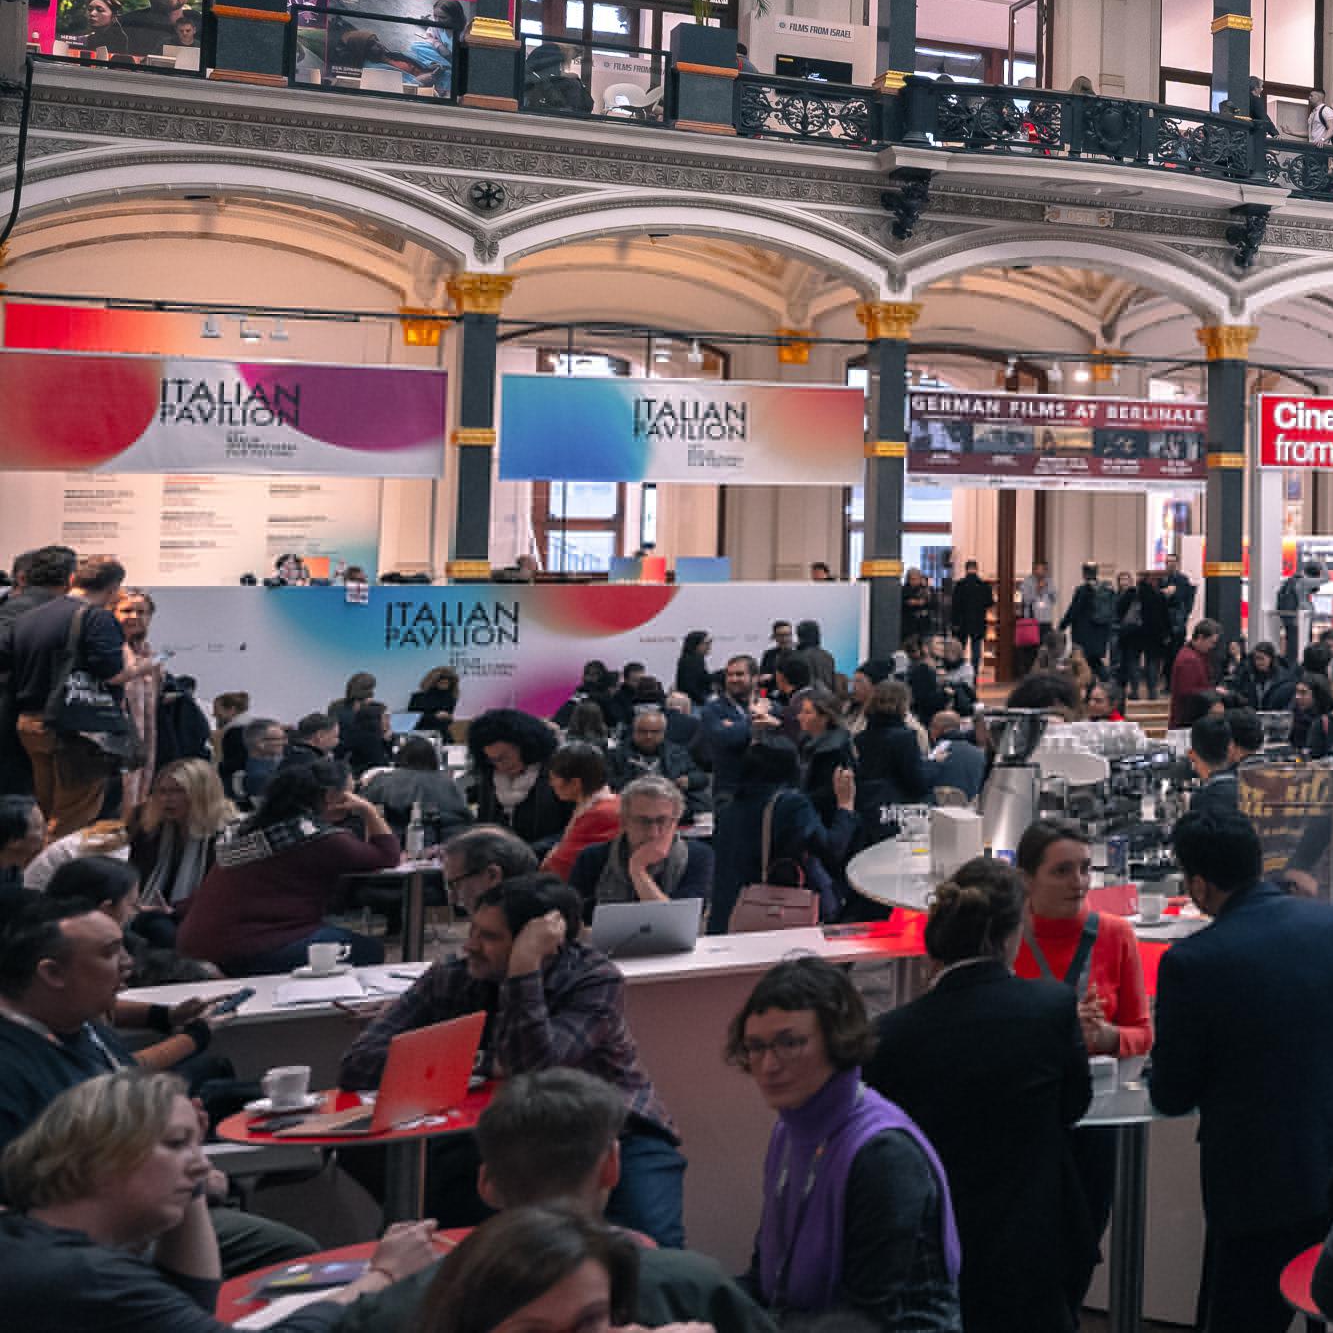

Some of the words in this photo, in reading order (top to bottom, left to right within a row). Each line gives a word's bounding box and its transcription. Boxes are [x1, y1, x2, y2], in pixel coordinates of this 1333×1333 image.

[789, 23, 809, 33] FILMS
[810, 25, 829, 36] FROM
[829, 28, 852, 39] ISRAEL
[614, 62, 632, 72] FILMS
[162, 378, 300, 406] ITALIAN
[160, 402, 300, 426] PAVILION
[634, 398, 747, 421] ITALIAN
[911, 395, 1001, 414] GERMAN
[1009, 400, 1066, 418] FILMS
[1069, 404, 1099, 419] AT
[1106, 405, 1206, 423] BERLINALE
[634, 418, 747, 440] PAVILION
[385, 602, 520, 627] ITALIAN
[384, 626, 520, 649] PAVILION
